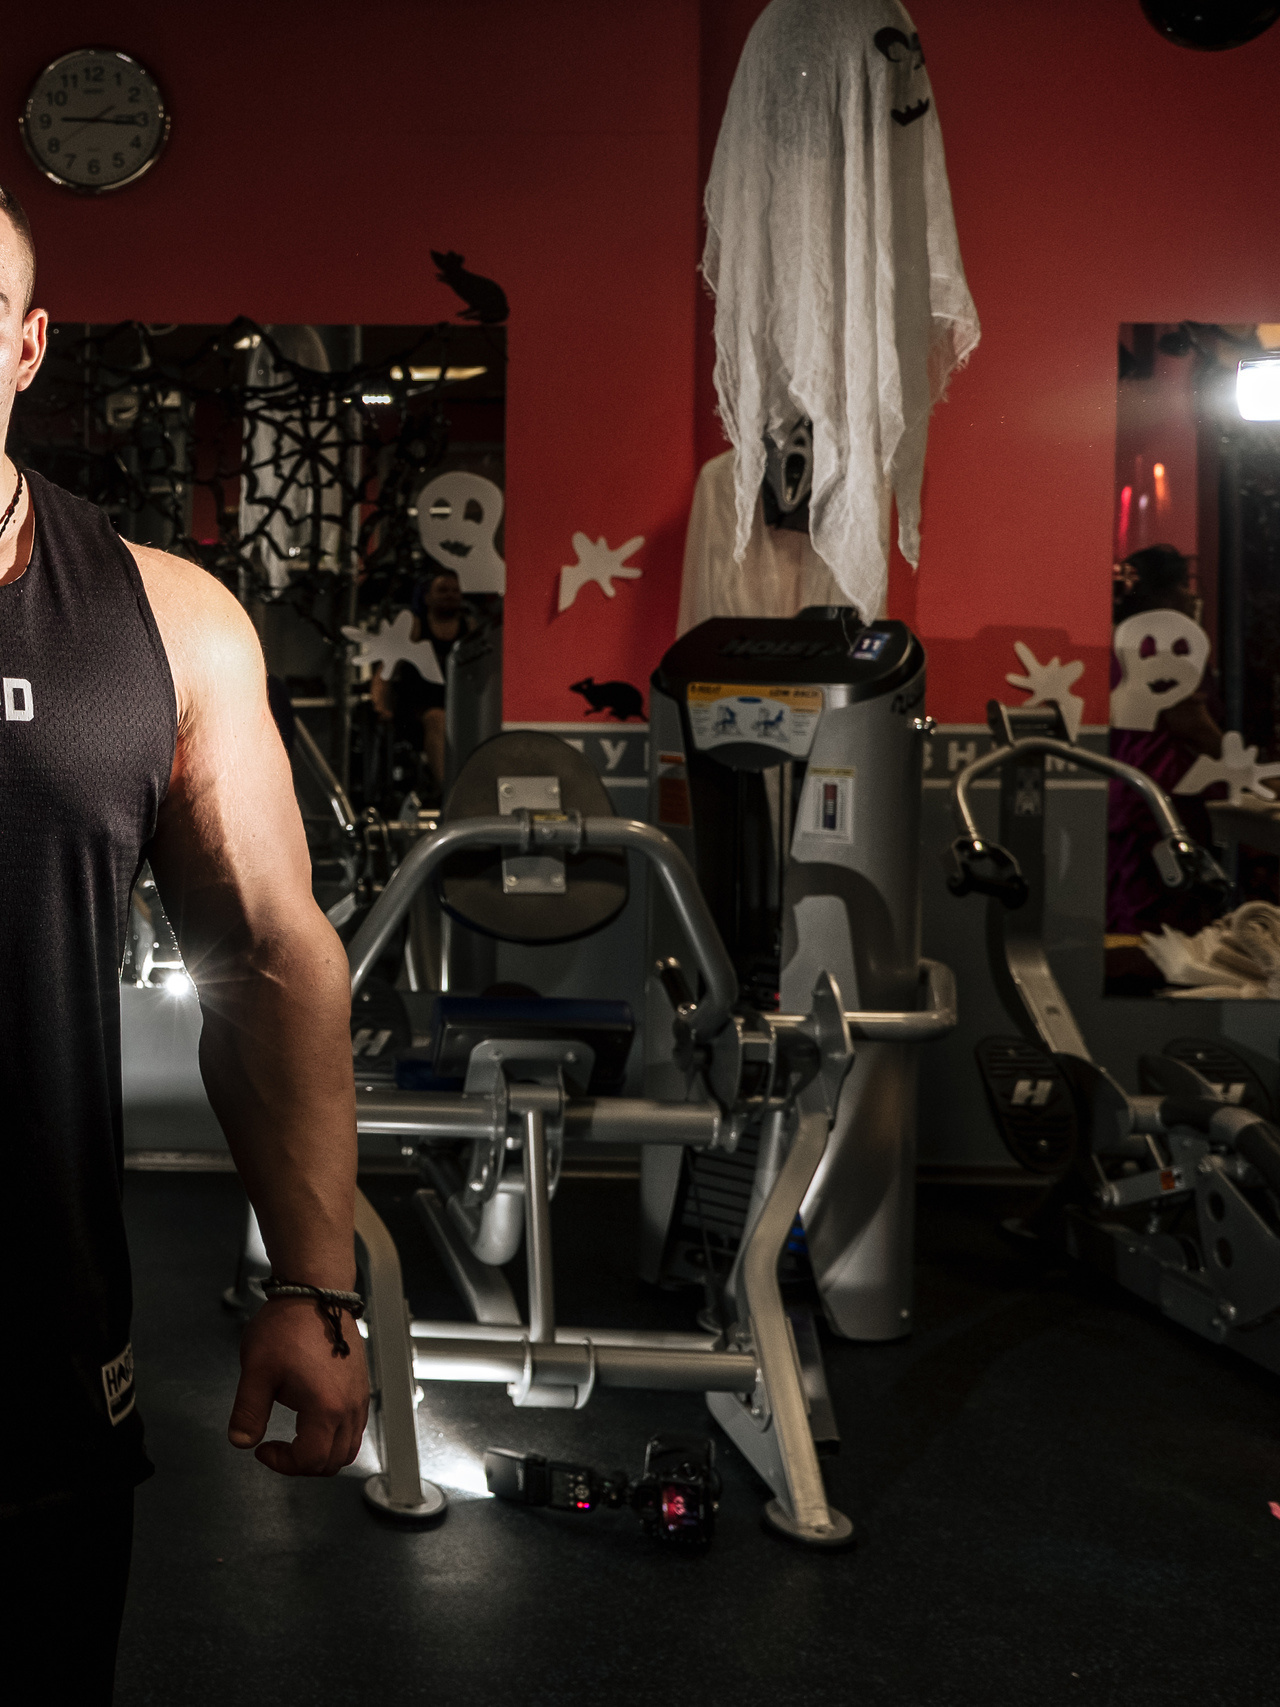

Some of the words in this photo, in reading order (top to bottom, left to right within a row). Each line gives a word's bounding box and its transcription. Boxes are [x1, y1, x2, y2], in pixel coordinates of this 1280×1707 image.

[61, 74, 78, 88] 11
[83, 66, 105, 82] 12
[115, 73, 121, 86] 1
[46, 90, 68, 106] 10
[128, 86, 141, 103] 2
[39, 113, 52, 130] 9
[135, 111, 148, 128] 3
[47, 137, 61, 154] 8
[129, 135, 141, 149] 4
[64, 153, 77, 168] 7
[87, 158, 101, 175] 6
[112, 152, 125, 168] 5
